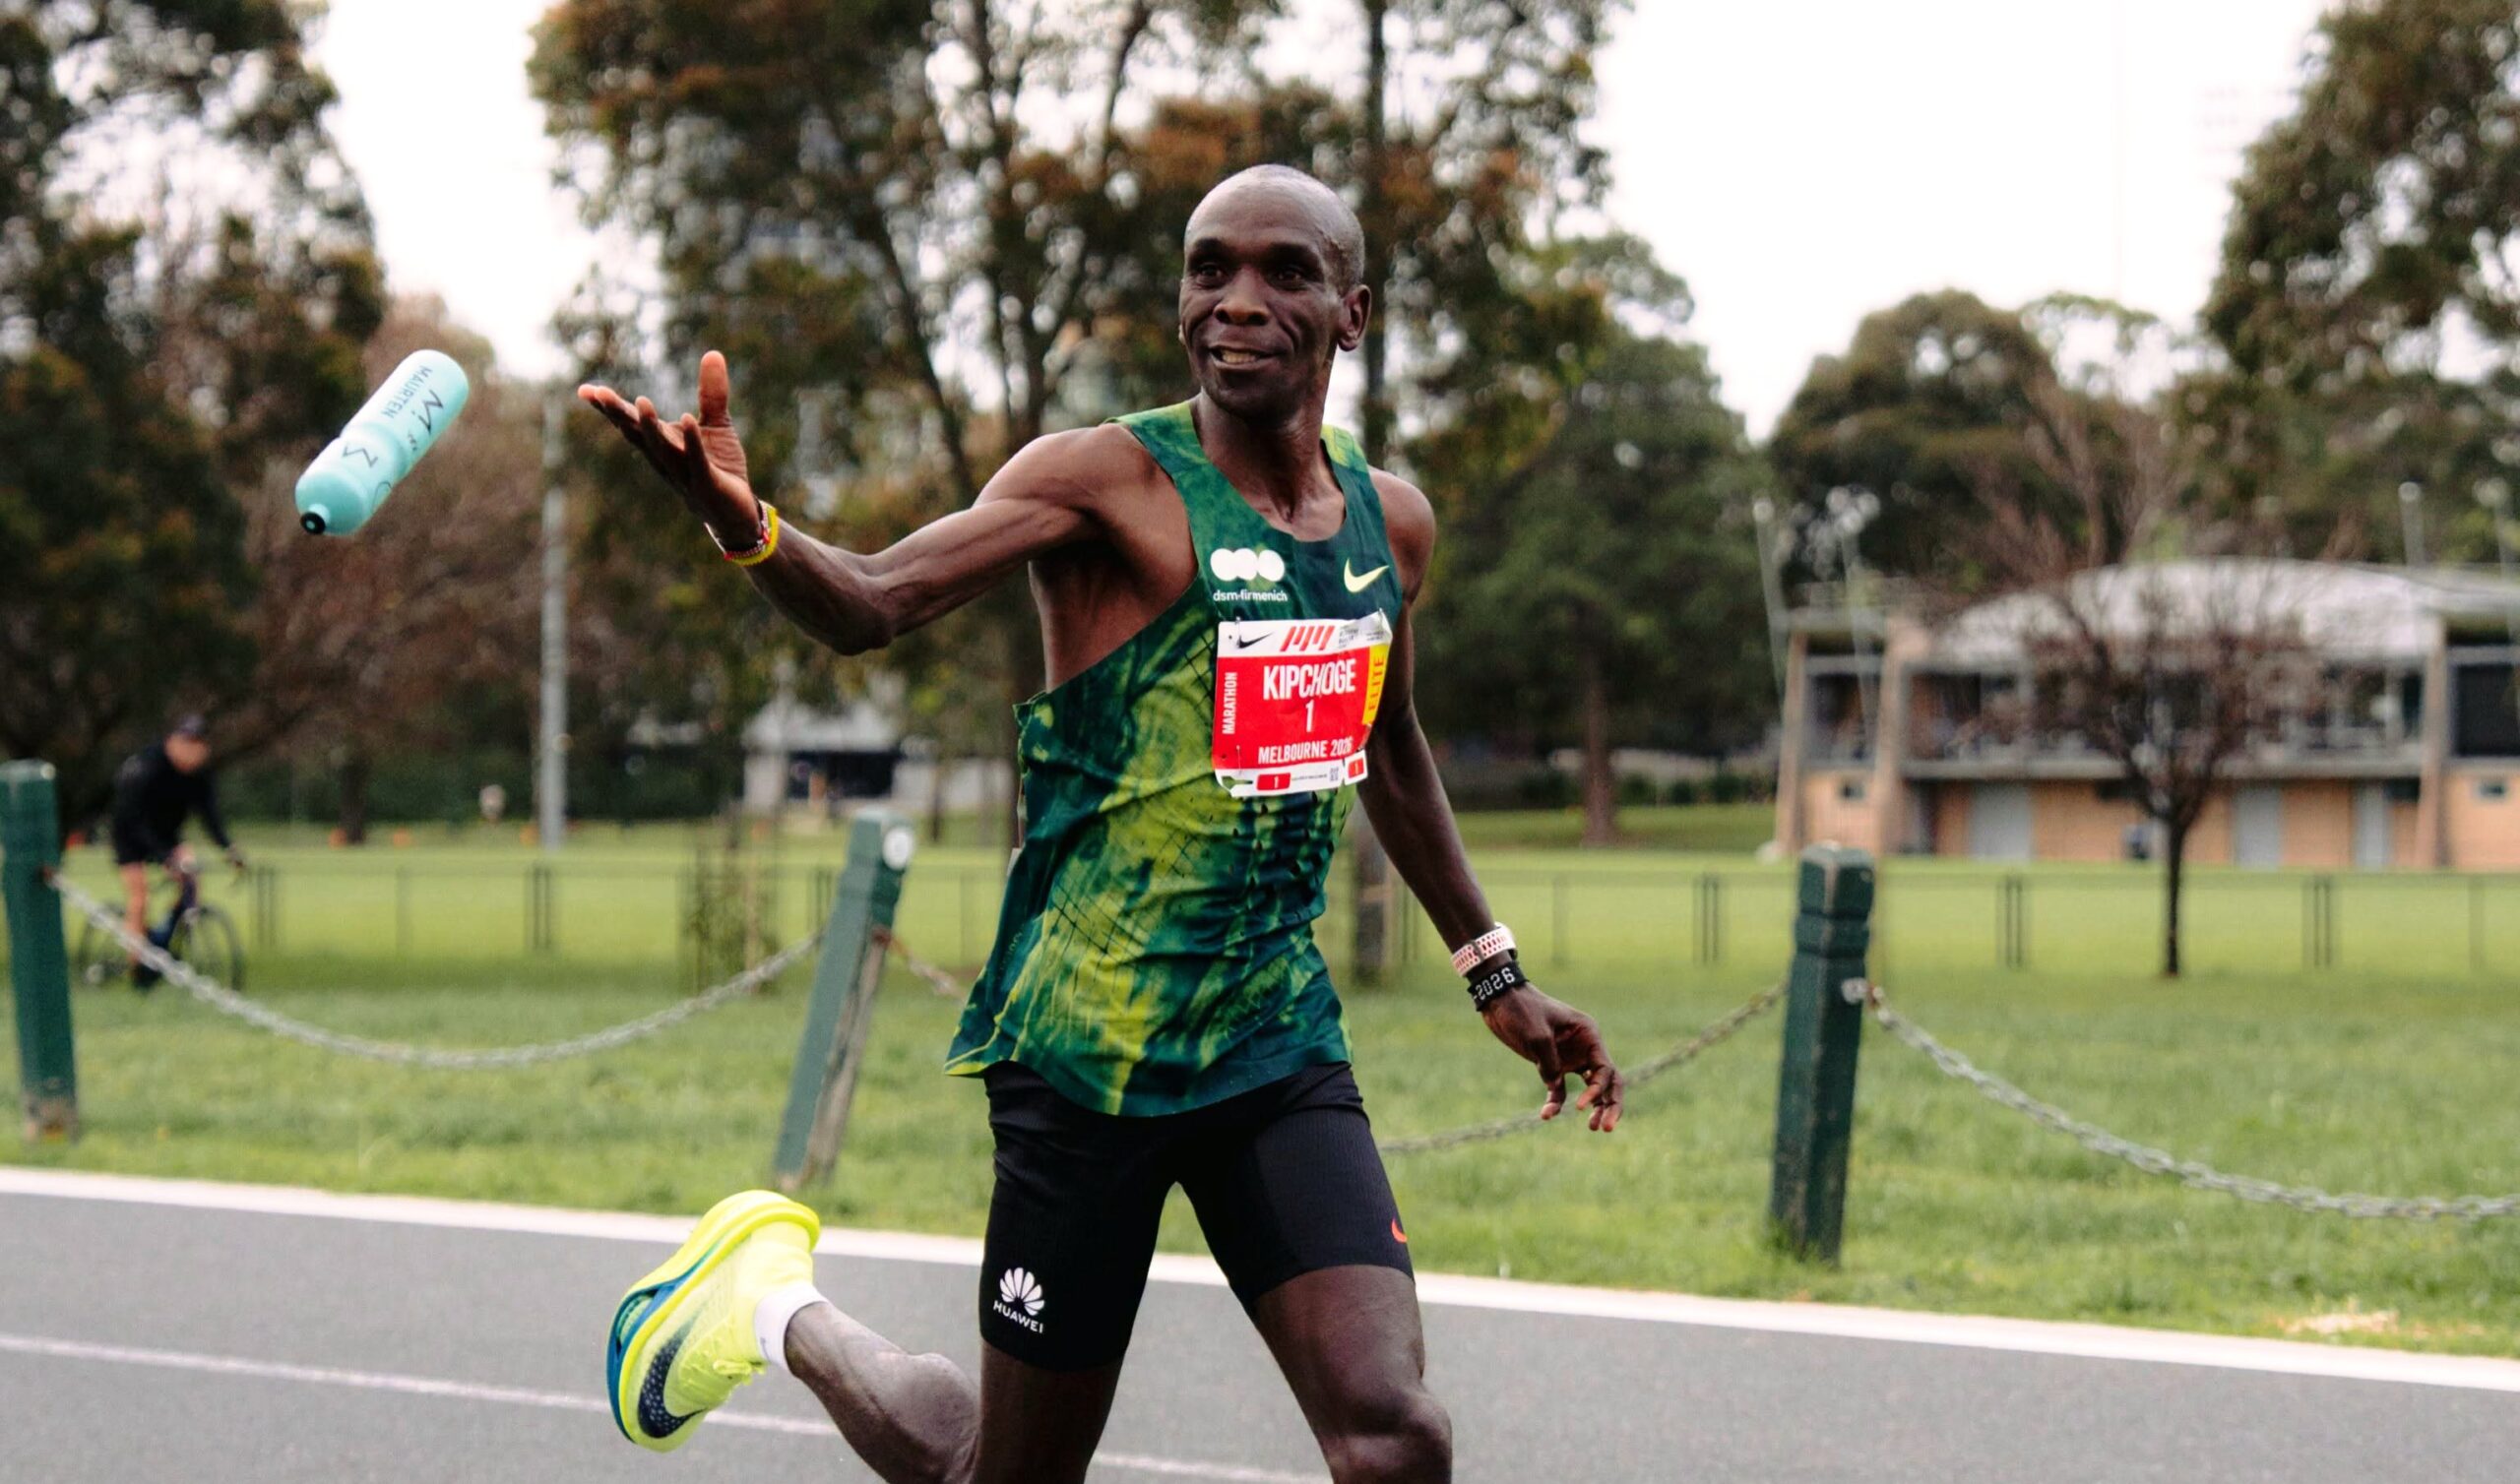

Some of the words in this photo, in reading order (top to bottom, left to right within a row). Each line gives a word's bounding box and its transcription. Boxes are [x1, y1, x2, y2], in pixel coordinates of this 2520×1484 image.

[380, 365, 433, 419] MAURTEN
[1213, 588, 1289, 602] dsm-firmenich
[1263, 658, 1356, 701] KIPCHOGE
[1222, 671, 1238, 735] MARATHON
[1305, 699, 1315, 733] 1
[1257, 740, 1329, 765] MELBOURNE
[1274, 775, 1280, 789] 1
[992, 1300, 1044, 1333] HUAWEI
